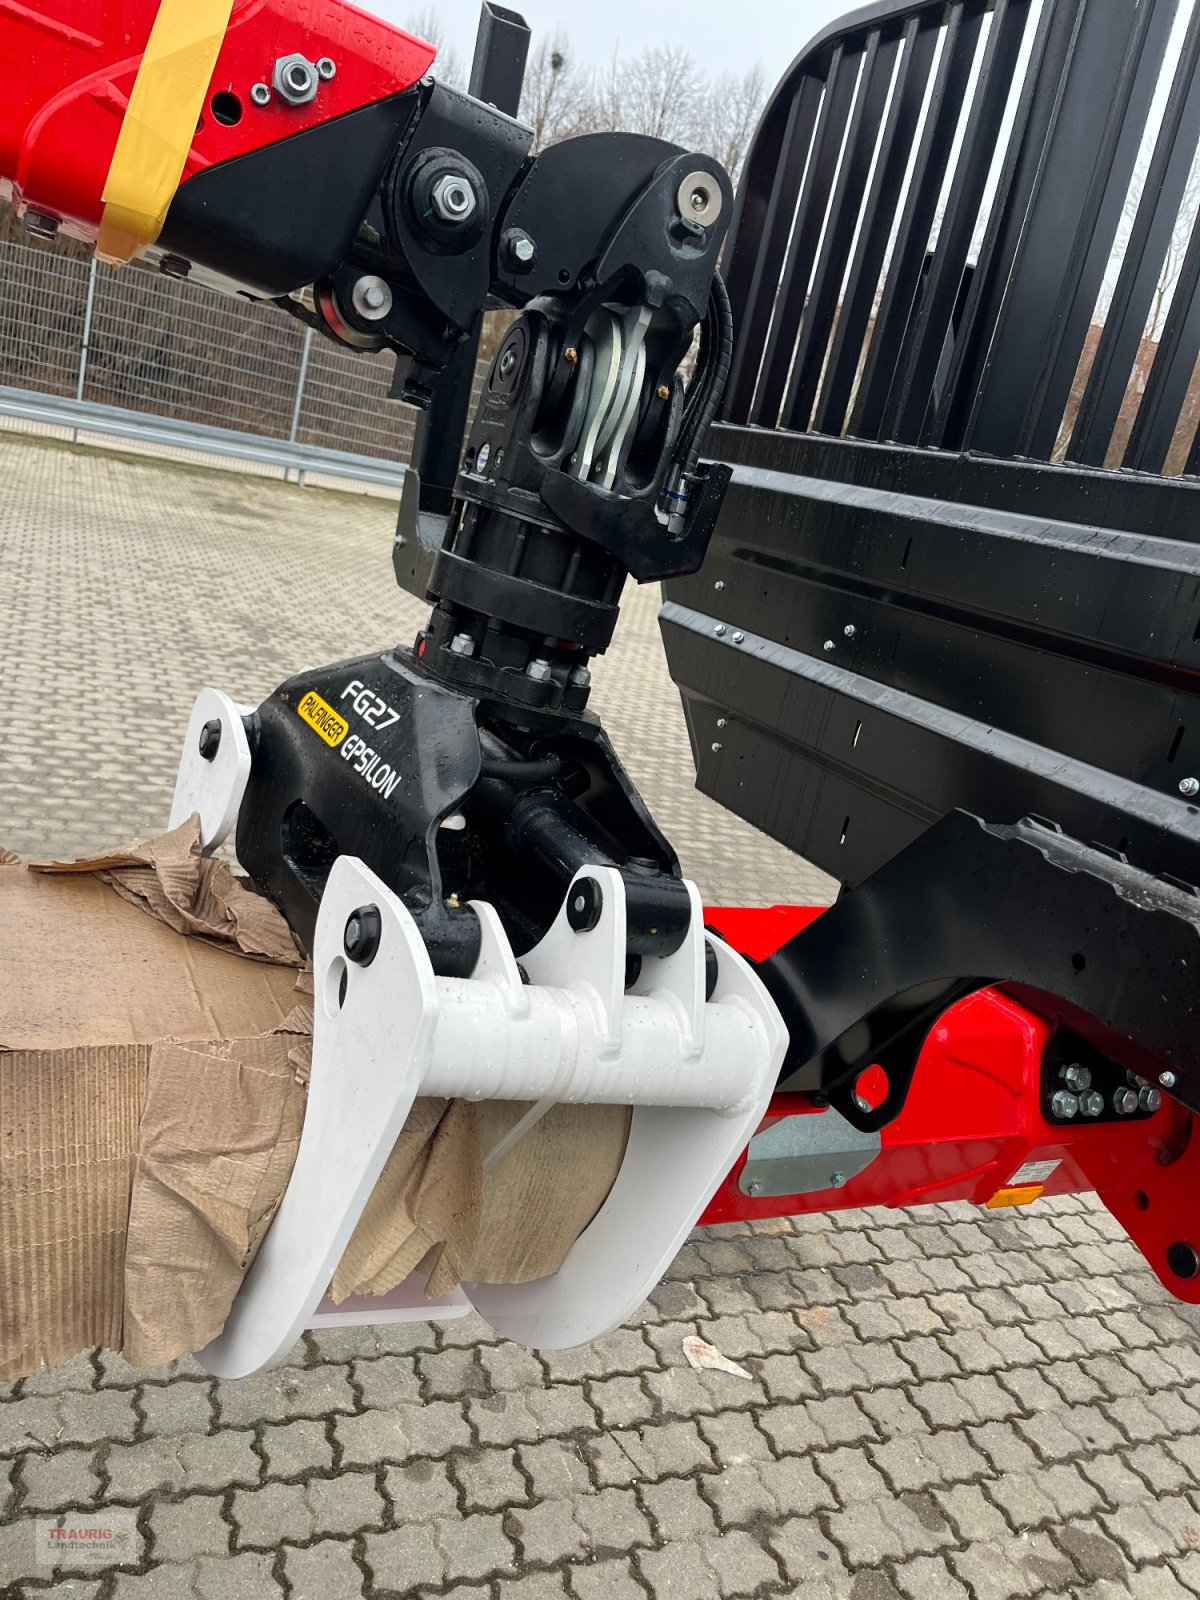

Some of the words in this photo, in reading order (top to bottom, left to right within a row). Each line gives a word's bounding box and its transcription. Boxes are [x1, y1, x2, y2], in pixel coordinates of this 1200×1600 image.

[340, 680, 401, 731] FG27
[300, 695, 345, 743] PALFINGER
[340, 734, 402, 800] EPSILON
